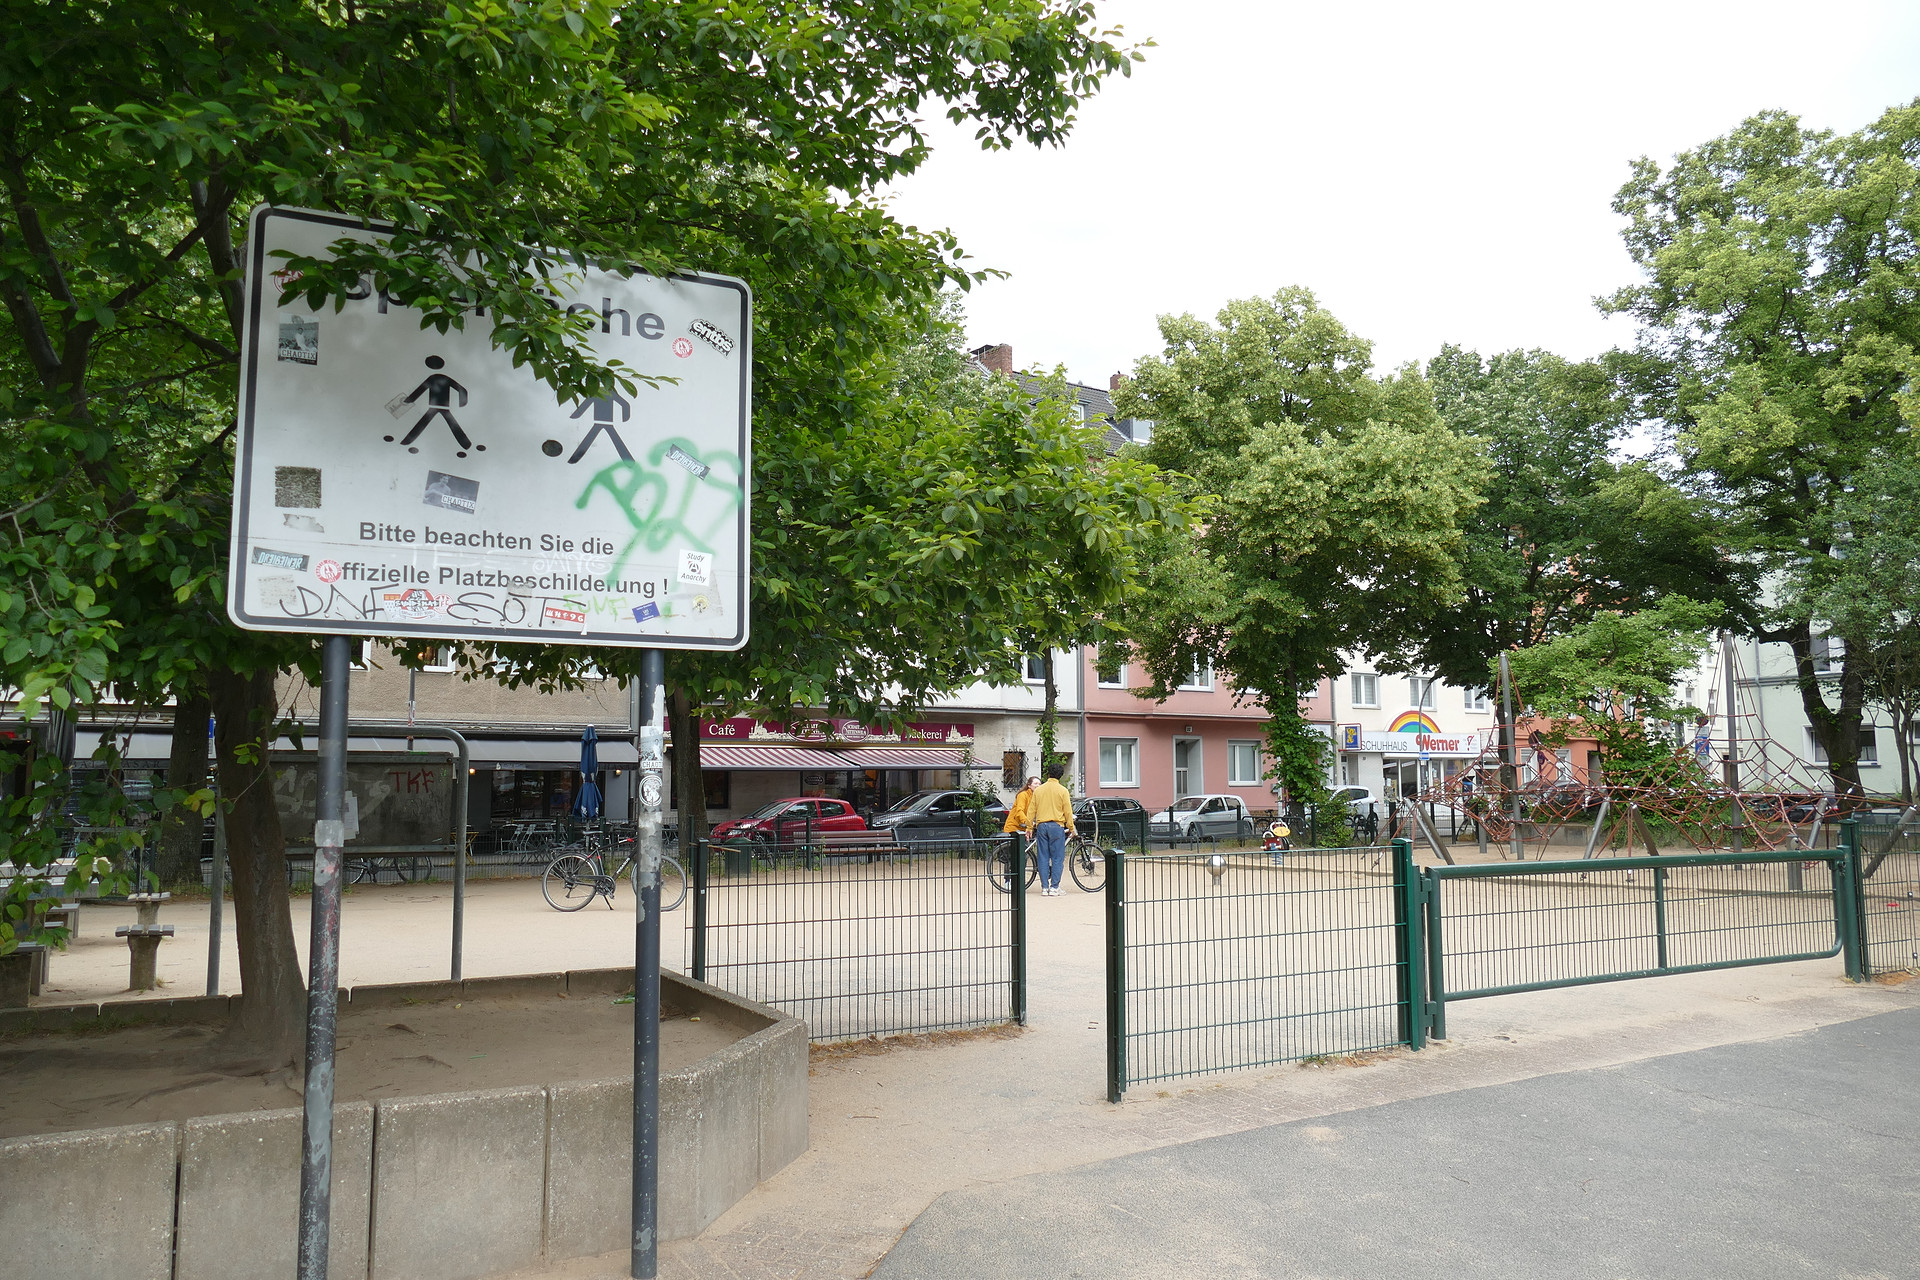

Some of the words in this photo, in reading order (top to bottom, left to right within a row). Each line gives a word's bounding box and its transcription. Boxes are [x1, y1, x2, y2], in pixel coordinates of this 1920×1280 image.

[282, 349, 316, 359] CHAOTIX
[360, 521, 416, 543] Bitte
[425, 525, 532, 551] beachten
[540, 533, 574, 552] Sie
[582, 537, 614, 555] die
[686, 552, 704, 562] Study
[341, 562, 430, 584] ffizielle
[439, 567, 655, 598] Platzbeschilderung
[680, 573, 707, 583] Anarchy
[709, 723, 735, 736] Café
[1362, 741, 1407, 751] SCHUHHAUS
[1416, 734, 1459, 751] Werner
